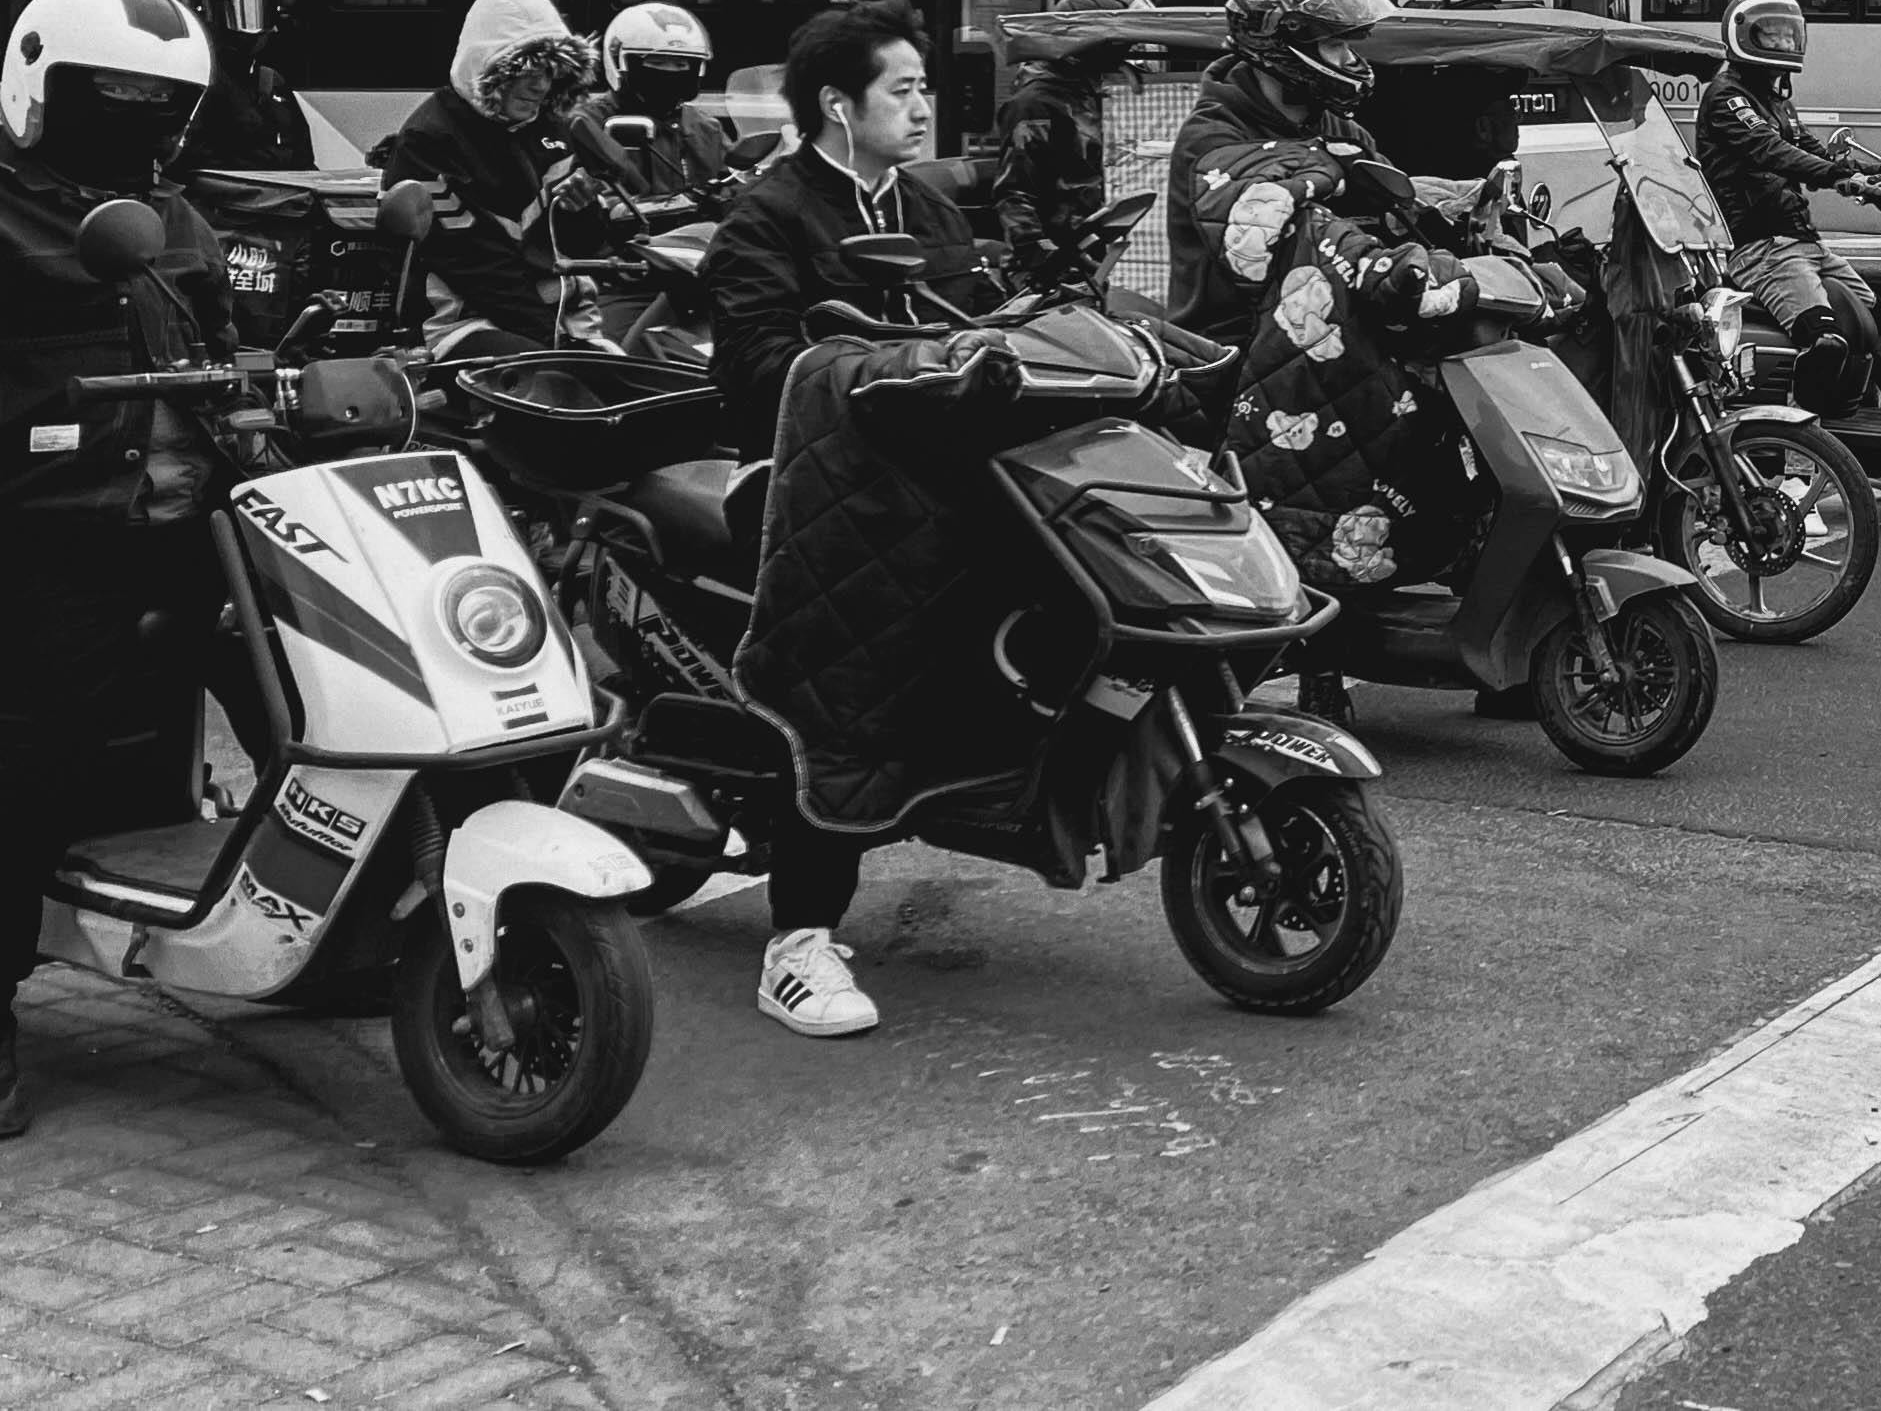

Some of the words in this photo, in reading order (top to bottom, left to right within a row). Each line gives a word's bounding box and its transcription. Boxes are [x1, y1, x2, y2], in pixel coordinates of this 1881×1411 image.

[373, 477, 463, 509] N7KC
[393, 502, 464, 519] POWERSPORT
[1373, 479, 1416, 518] LOVELY
[232, 488, 350, 564] FAST
[496, 697, 545, 716] KAIYUE
[286, 778, 366, 839] HKS
[239, 870, 314, 932] MAX
